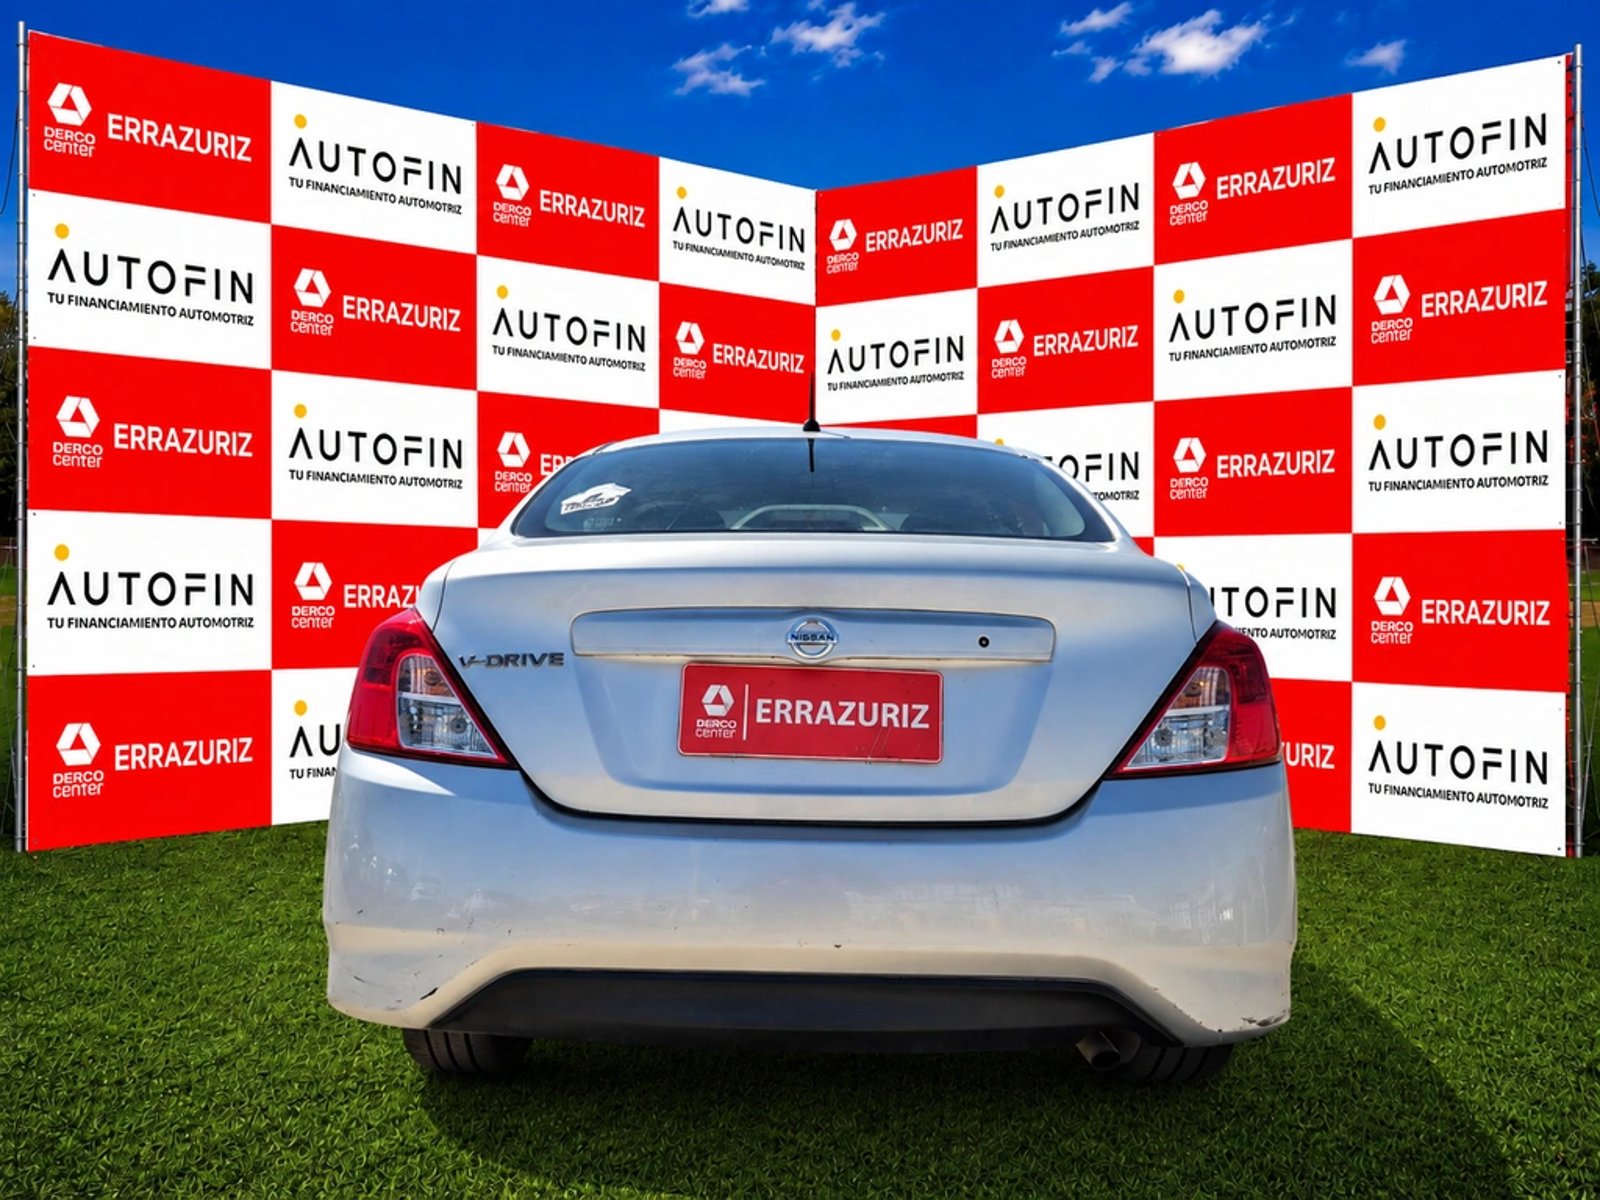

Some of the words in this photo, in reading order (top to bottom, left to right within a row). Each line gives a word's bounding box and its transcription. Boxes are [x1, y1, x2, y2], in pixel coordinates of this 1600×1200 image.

[44, 126, 96, 145] DERCO
[44, 138, 95, 157] center
[108, 113, 252, 162] ERRAZURIZ
[1368, 113, 1547, 175] AUTOFIN
[289, 137, 462, 195] AUTOFIN
[1368, 183, 1382, 195] TU
[1383, 168, 1475, 193] FINANCIAMIENTO
[1476, 157, 1548, 179] AUTOMOTRIZ
[1217, 157, 1336, 200] ERRAZURIZ
[288, 176, 304, 189] TU
[306, 179, 397, 204] FINANCIAMIENTO
[398, 195, 462, 216] AUTOMOTRIZ
[990, 182, 1139, 234] AUTOFIN
[1170, 199, 1209, 216] DERCO
[493, 202, 532, 217] DERCO
[493, 212, 530, 227] center
[540, 189, 645, 228] ERRAZURIZ
[1170, 210, 1208, 226] center
[673, 206, 805, 254] AUTOFIN
[865, 218, 964, 253] ERRAZURIZ
[990, 241, 1003, 252] TU
[1003, 230, 1079, 250] FINANCIAMIENTO
[1079, 220, 1140, 239] AUTOMOTRIZ
[672, 240, 684, 251] TU
[685, 242, 755, 263] FINANCIAMIENTO
[755, 254, 806, 271] AUTOMOTRIZ
[827, 252, 860, 265] DERCO
[47, 248, 253, 304] AUTOFIN
[47, 291, 65, 305] TU
[67, 294, 177, 318] FINANCIAMIENTO
[178, 307, 254, 327] AUTOMOTRIZ
[1421, 280, 1548, 318] ERRAZURIZ
[291, 310, 334, 325] DERCO
[343, 295, 461, 332] ERRAZURIZ
[1169, 294, 1336, 343] AUTOFIN
[1371, 317, 1412, 332] DERCO
[290, 321, 333, 336] center
[492, 307, 645, 353] AUTOFIN
[1371, 328, 1412, 344] center
[1033, 325, 1139, 357] ERRAZURIZ
[1168, 352, 1182, 362] TU
[1183, 342, 1268, 361] FINANCIAMIENTO
[1269, 335, 1337, 352] AUTOMOTRIZ
[492, 344, 506, 356] TU
[506, 346, 588, 366] FINANCIAMIENTO
[588, 356, 646, 372] AUTOMOTRIZ
[673, 357, 707, 370] DERCO
[713, 343, 805, 374] ERRAZURIZ
[827, 335, 964, 375] AUTOFIN
[991, 356, 1027, 368] DERCO
[827, 382, 838, 392] TU
[839, 376, 909, 390] FINANCIAMIENTO
[909, 371, 965, 384] AUTOMOTRIZ
[991, 365, 1026, 379] center
[53, 441, 103, 456] DERCO
[114, 423, 253, 458] ERRAZURIZ
[288, 427, 462, 470] AUTOFIN
[1369, 430, 1548, 471] AUTOFIN
[53, 454, 103, 468] center
[1044, 451, 1139, 483] OFIN
[1217, 449, 1336, 479] ERRAZURIZ
[288, 469, 304, 481] TU
[306, 470, 398, 486] FINANCIAMIENTO
[398, 476, 463, 490] AUTOMOTRIZ
[494, 471, 533, 482] DERCO
[494, 481, 532, 493] center
[1170, 477, 1209, 489] DERCO
[1368, 481, 1382, 492] TU
[1383, 477, 1476, 492] FINANCIAMIENTO
[1476, 474, 1549, 489] AUTOMOTRIZ
[1170, 487, 1207, 500] center
[47, 571, 253, 607] AUTOFIN
[343, 584, 420, 608] ERRAZ
[291, 605, 336, 617] DERCO
[1209, 586, 1337, 618] TOFIN
[1421, 600, 1551, 626] ERRAZURIZ
[47, 617, 65, 629] TU
[67, 617, 178, 629] FINANCIAMIENTO
[178, 617, 255, 629] AUTOMOTRIZ
[291, 616, 334, 629] center
[1269, 628, 1337, 640] AUTOMOTRIZ
[1371, 620, 1412, 633] DERCO
[791, 633, 834, 641] NISSAN
[1371, 632, 1412, 645] center
[696, 719, 737, 729] DERCO
[755, 698, 930, 729] ERRAZURIZ
[695, 728, 736, 738] center
[115, 737, 253, 771] ERRAZURIZ
[1368, 740, 1548, 785] AUTOFIN
[53, 770, 104, 785] DERCO
[289, 768, 304, 780] TU
[53, 782, 104, 798] center
[1368, 782, 1382, 795] TU
[1383, 784, 1476, 804] FINANCIAMIENTO
[1476, 792, 1549, 810] AUTOMOTRIZ
